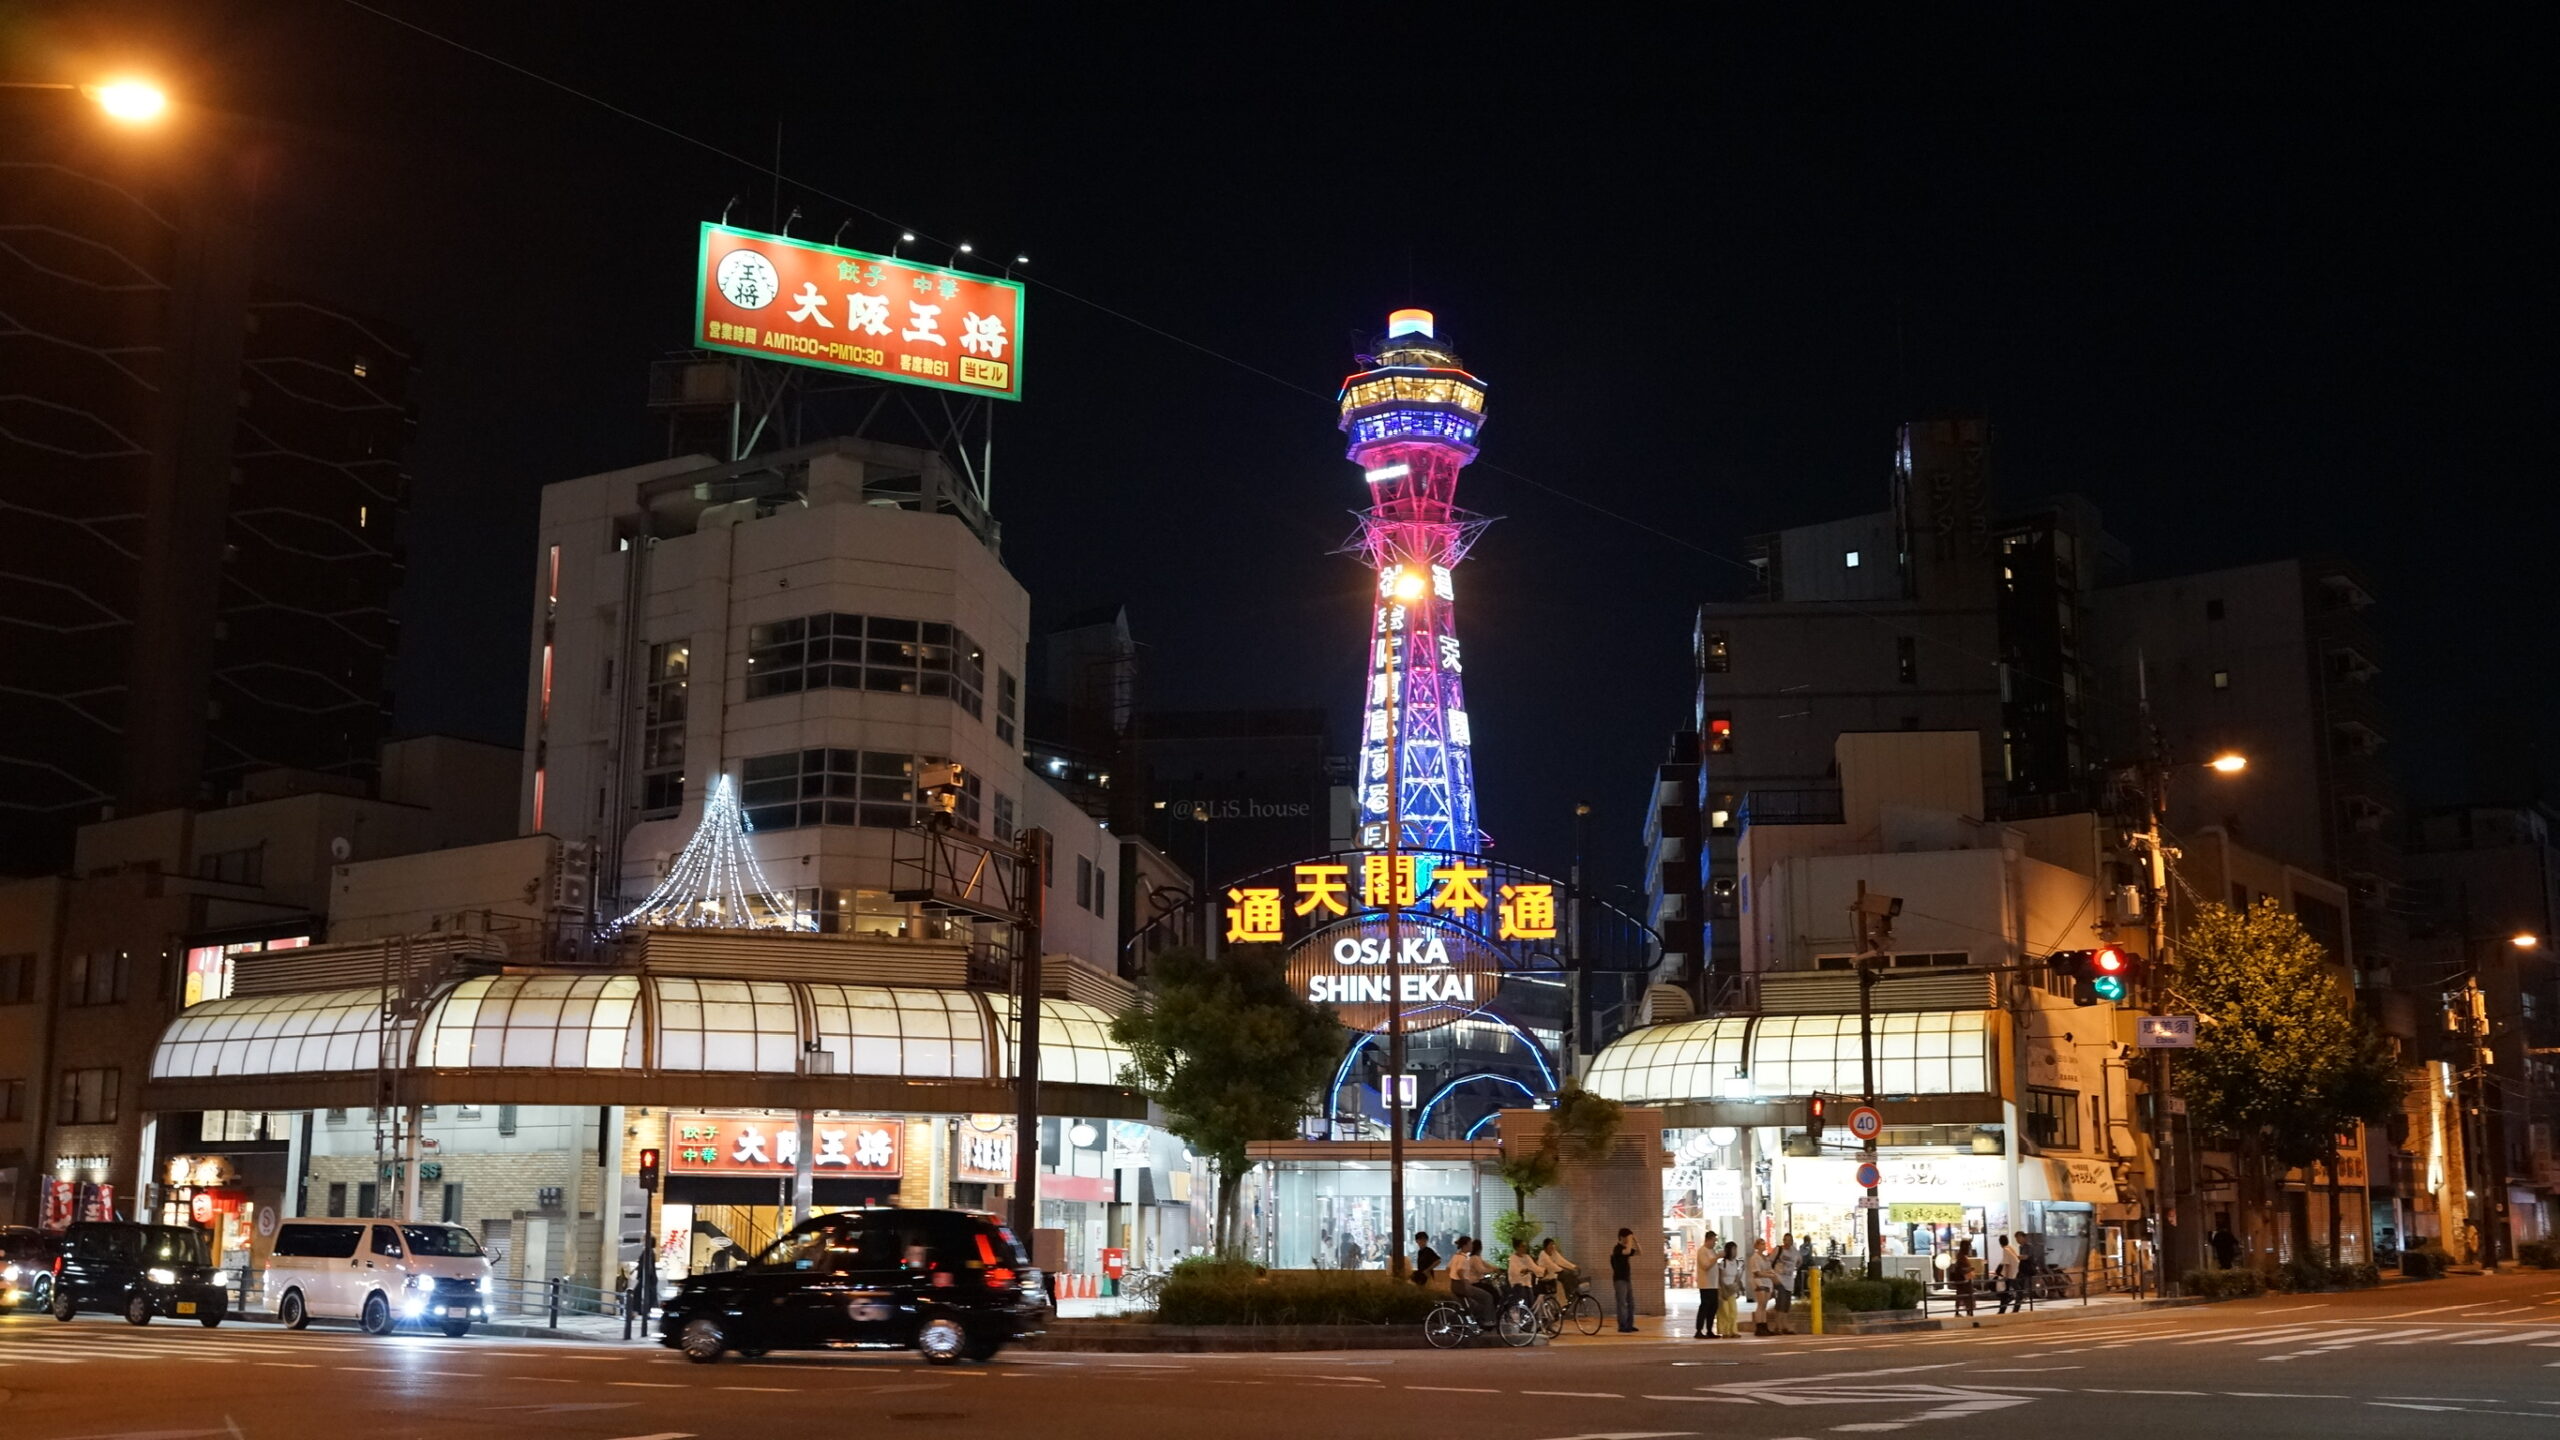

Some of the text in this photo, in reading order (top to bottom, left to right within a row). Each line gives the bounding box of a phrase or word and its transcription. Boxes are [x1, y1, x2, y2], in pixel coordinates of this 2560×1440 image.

[837, 260, 960, 300] 餃子 中華
[786, 282, 1008, 358] 大阪王将
[709, 320, 757, 346] 営業時間
[900, 354, 949, 377] 客席数61
[963, 361, 1004, 382] 当ビル
[1226, 855, 1557, 942] 通天閣本通
[1334, 937, 1449, 965] OSAKA
[1309, 974, 1474, 1002] SHINSEKAI
[681, 1126, 720, 1140] 餃子
[1857, 1116, 1875, 1131] 40
[681, 1147, 717, 1163] 中華
[733, 1126, 893, 1167] 大阪王将
